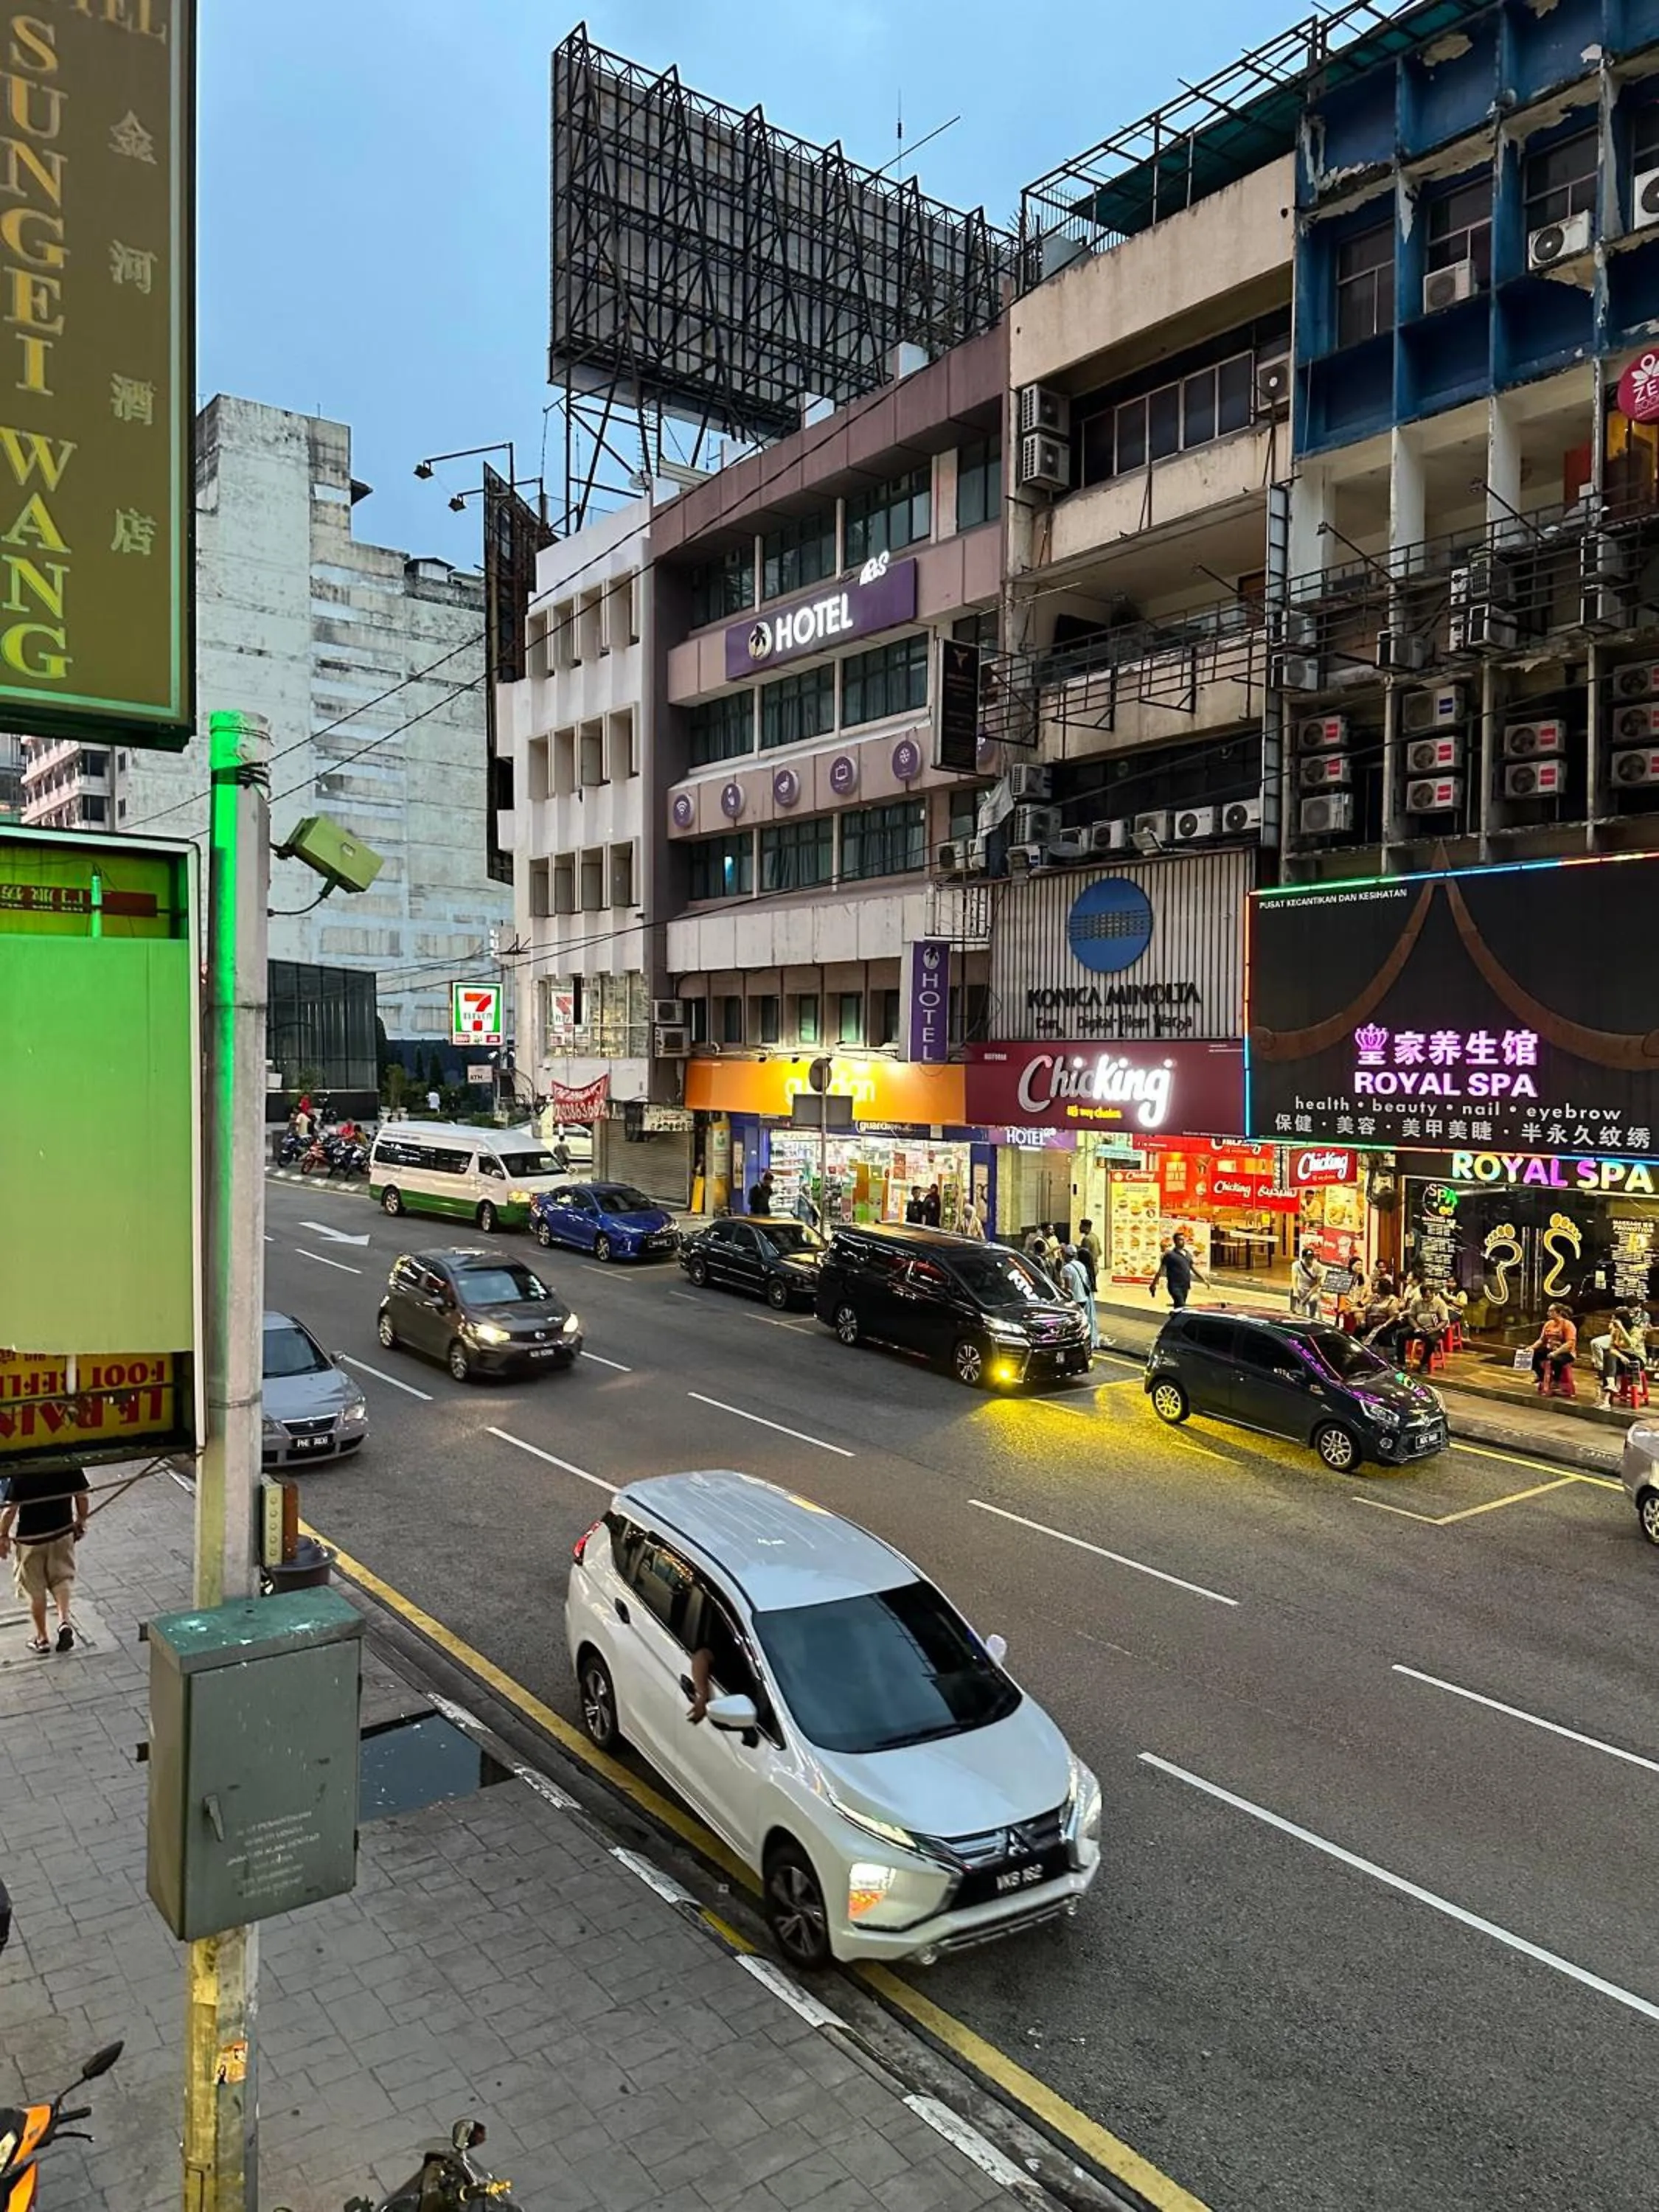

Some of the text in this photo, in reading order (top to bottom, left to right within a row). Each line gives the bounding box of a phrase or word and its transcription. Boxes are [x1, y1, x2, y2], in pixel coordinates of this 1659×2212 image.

[0, 14, 78, 680] SUNGEI WANG
[108, 109, 159, 556] 金河酒店
[775, 592, 854, 653] HOTEL
[1259, 888, 1408, 909] PUSAT KECANTIKAN DAN KESIHATAN
[465, 992, 492, 1031] 7
[1027, 982, 1201, 1009] KONICA MINOLTA
[919, 973, 941, 1060] HOTEL
[1354, 1023, 1539, 1066] 皇家养生馆
[1354, 1071, 1539, 1098] ROYAL SPA
[1295, 1096, 1622, 1121] health beauty nail eyebrow
[1006, 1128, 1046, 1146] HOTEL
[1275, 1113, 1652, 1150] 保健 美容 美甲美睫 半永久纹绣
[1451, 1151, 1655, 1194] ROYAL SPA
